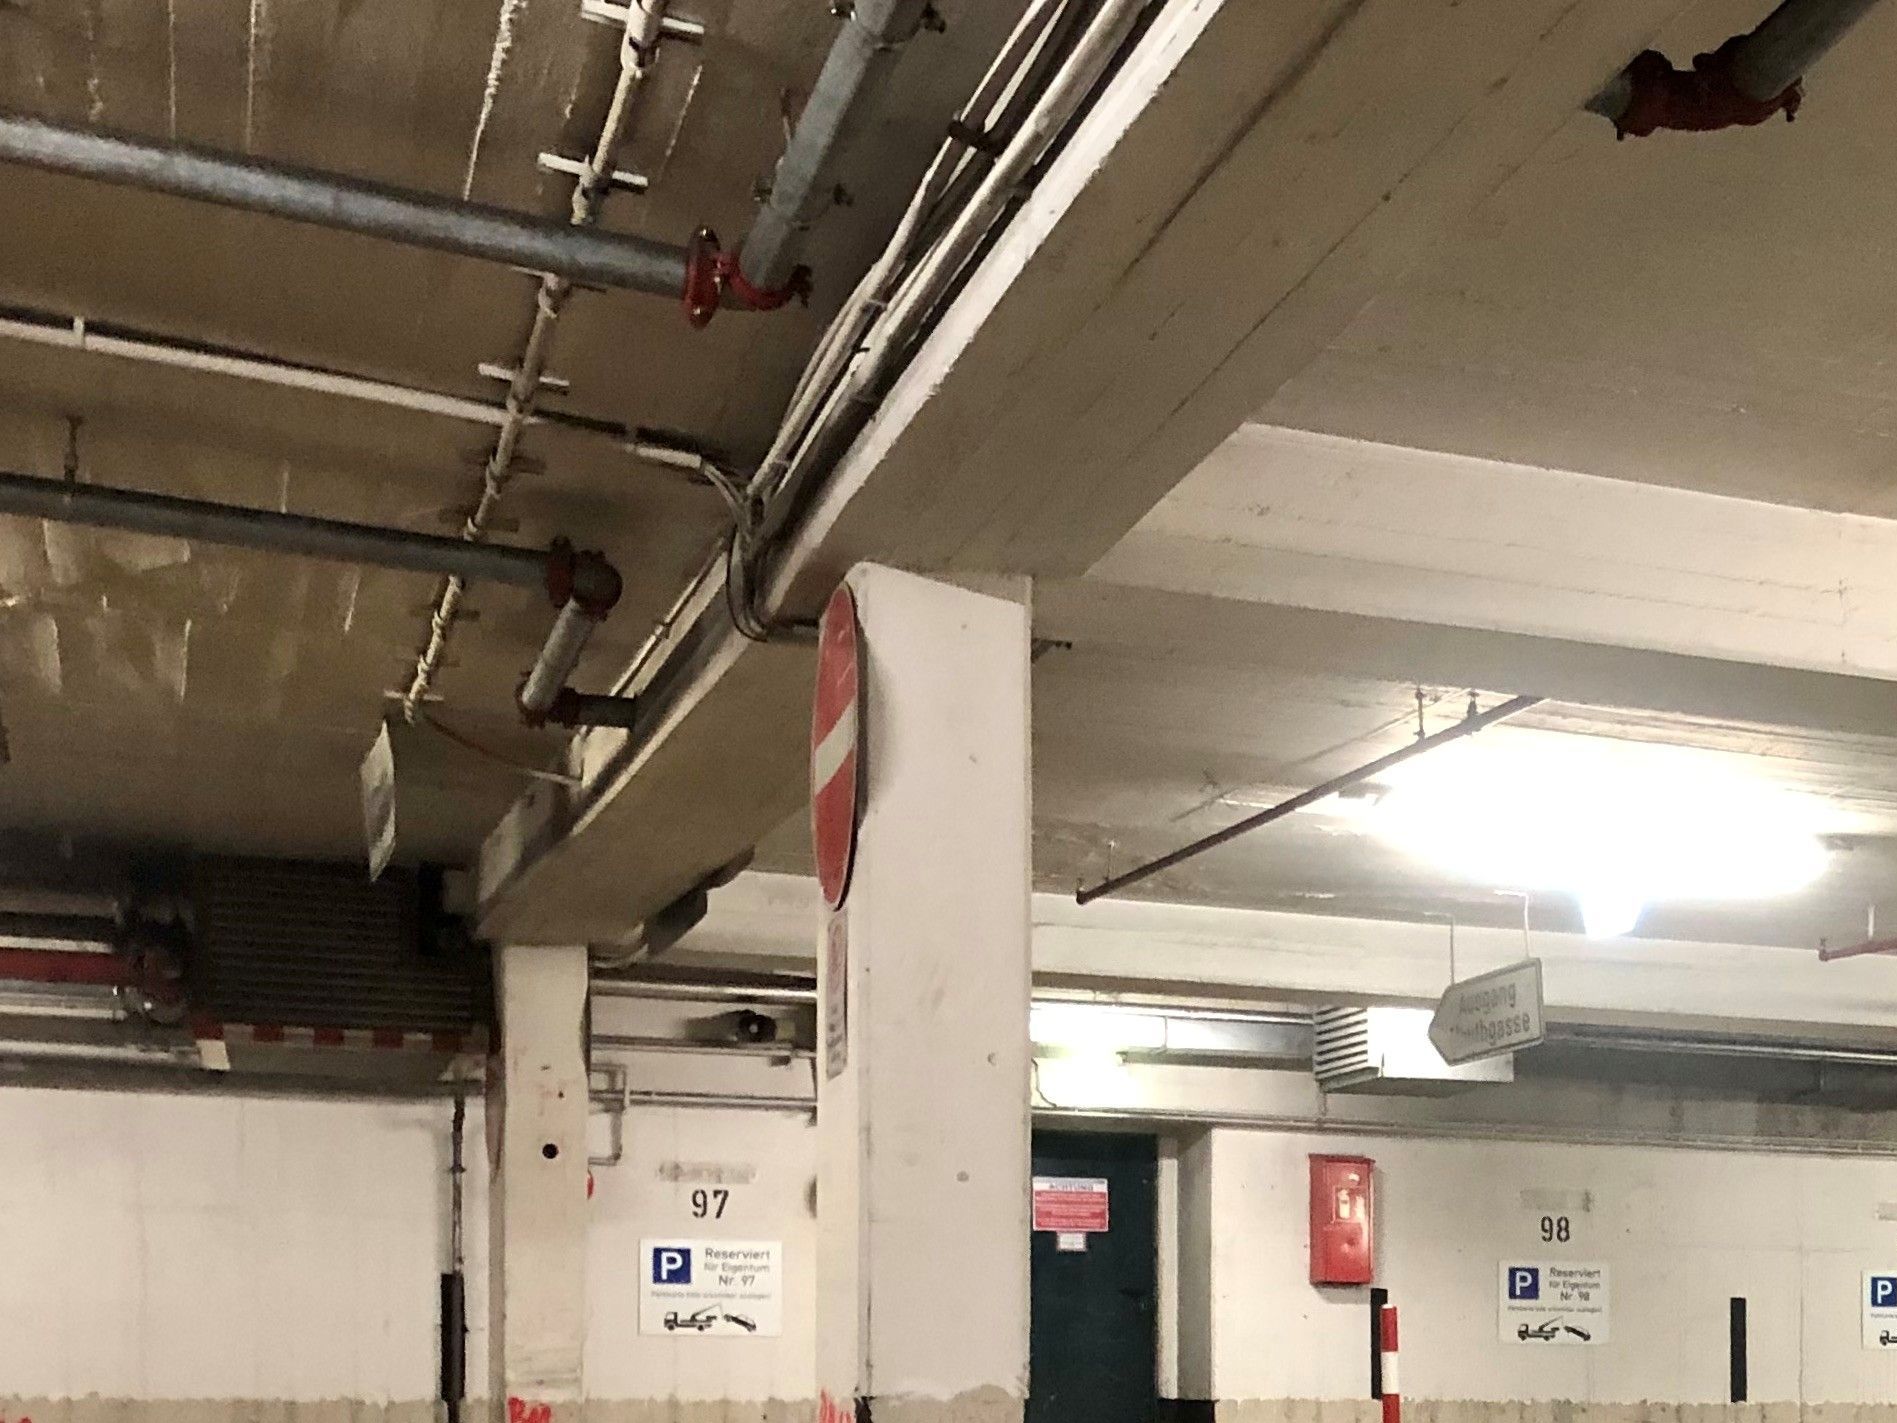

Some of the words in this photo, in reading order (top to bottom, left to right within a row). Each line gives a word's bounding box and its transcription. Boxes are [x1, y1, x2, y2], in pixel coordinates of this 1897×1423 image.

[691, 1189, 729, 1219] 97
[1540, 1216, 1571, 1242] 98
[705, 1247, 770, 1260] Reserviert
[661, 1251, 683, 1281] P
[721, 1262, 770, 1273] Eigentum
[1550, 1266, 1601, 1278] Reserviert
[741, 1275, 756, 1287] 97
[1514, 1271, 1533, 1296] P
[1877, 1280, 1893, 1304] P
